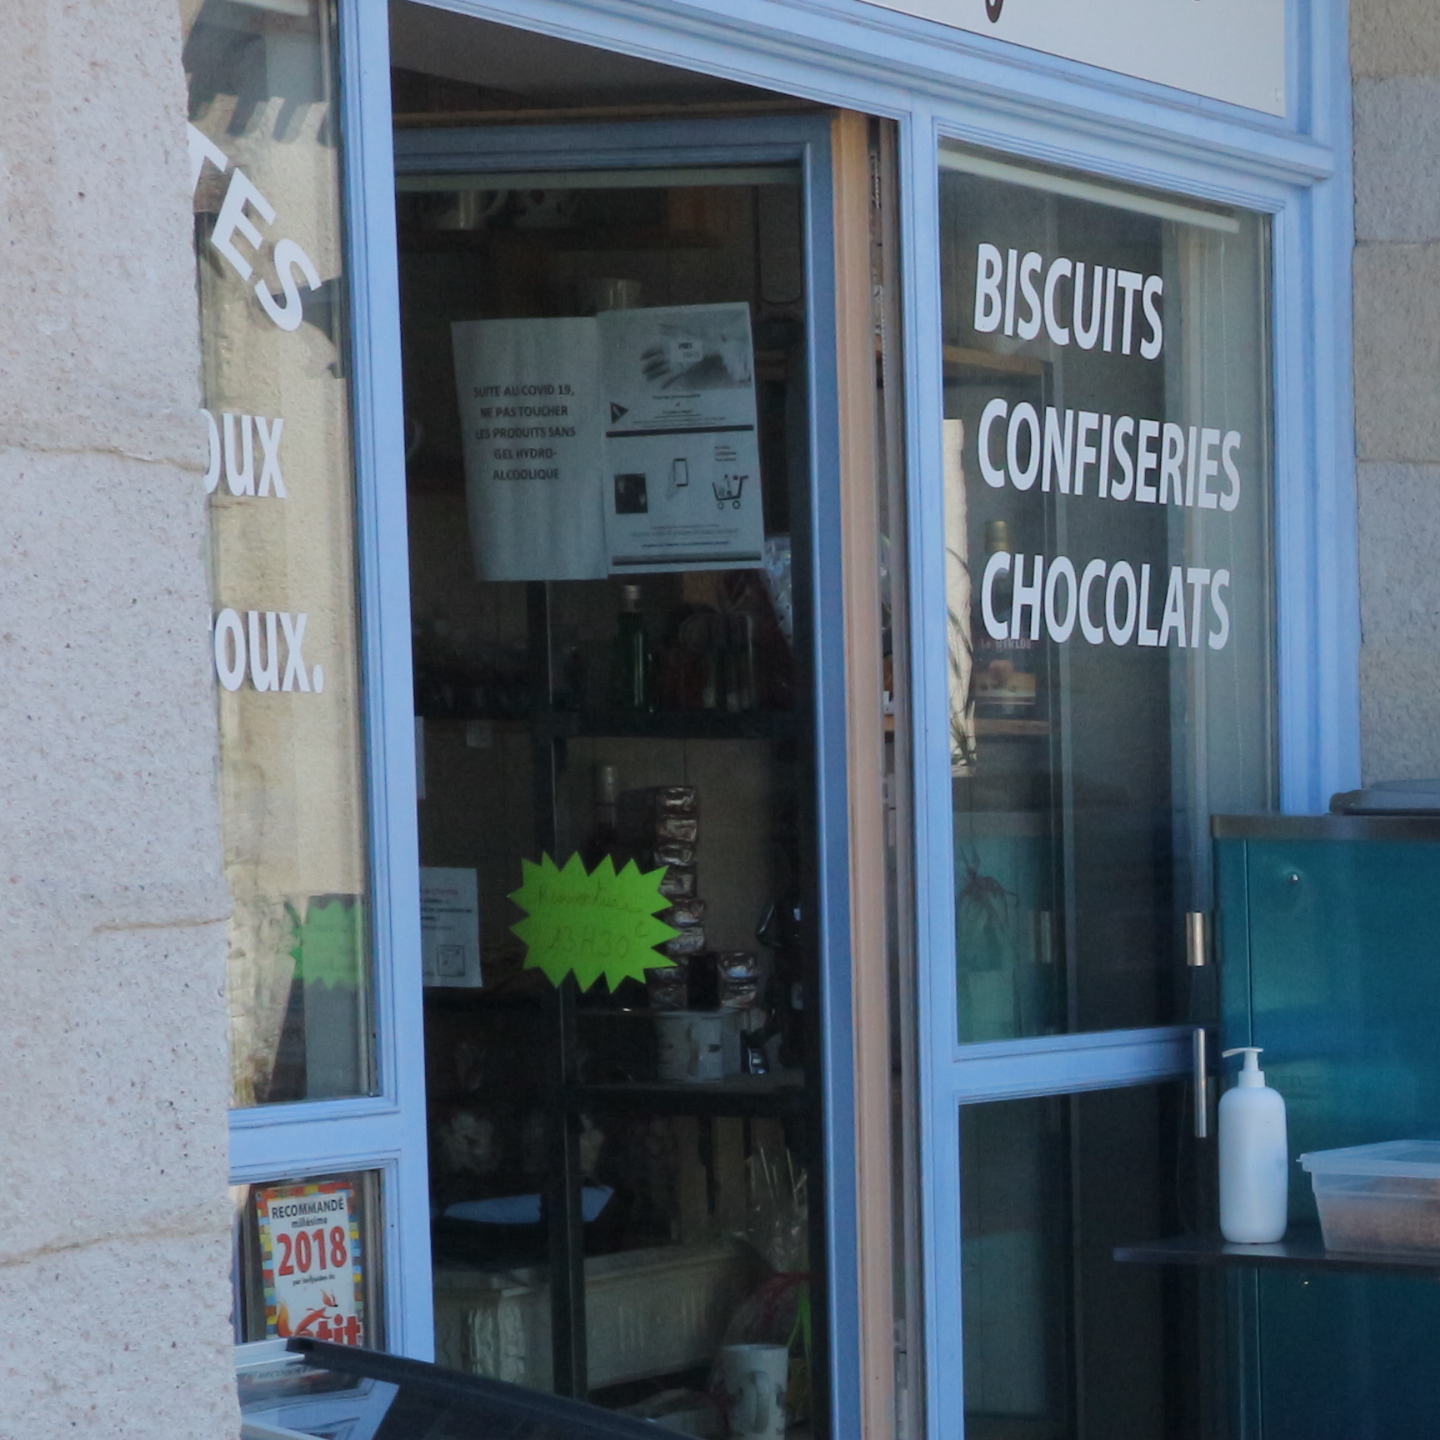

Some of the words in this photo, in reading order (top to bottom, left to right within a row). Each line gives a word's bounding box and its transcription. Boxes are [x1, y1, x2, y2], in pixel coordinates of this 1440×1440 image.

[974, 242, 1164, 361] BISCUITS
[473, 385, 500, 398] SUITE
[504, 385, 519, 397] AU
[521, 384, 555, 397] COVID
[480, 407, 492, 418] NE
[496, 406, 516, 418] PAS
[519, 405, 568, 417] TOUCHER
[475, 427, 491, 440] LES
[493, 426, 546, 439] PRODUITS
[548, 426, 576, 438] SANS
[493, 448, 513, 460] GEL
[516, 447, 557, 459] HYDRO-
[978, 397, 1242, 513] CONFISERIES
[493, 468, 560, 481] ALCOOLIQUE
[981, 551, 1231, 651] CHOCOLATS
[208, 607, 325, 694] oux.
[271, 1198, 345, 1220] RECOMMANDÉ
[276, 1225, 347, 1277] 2018
